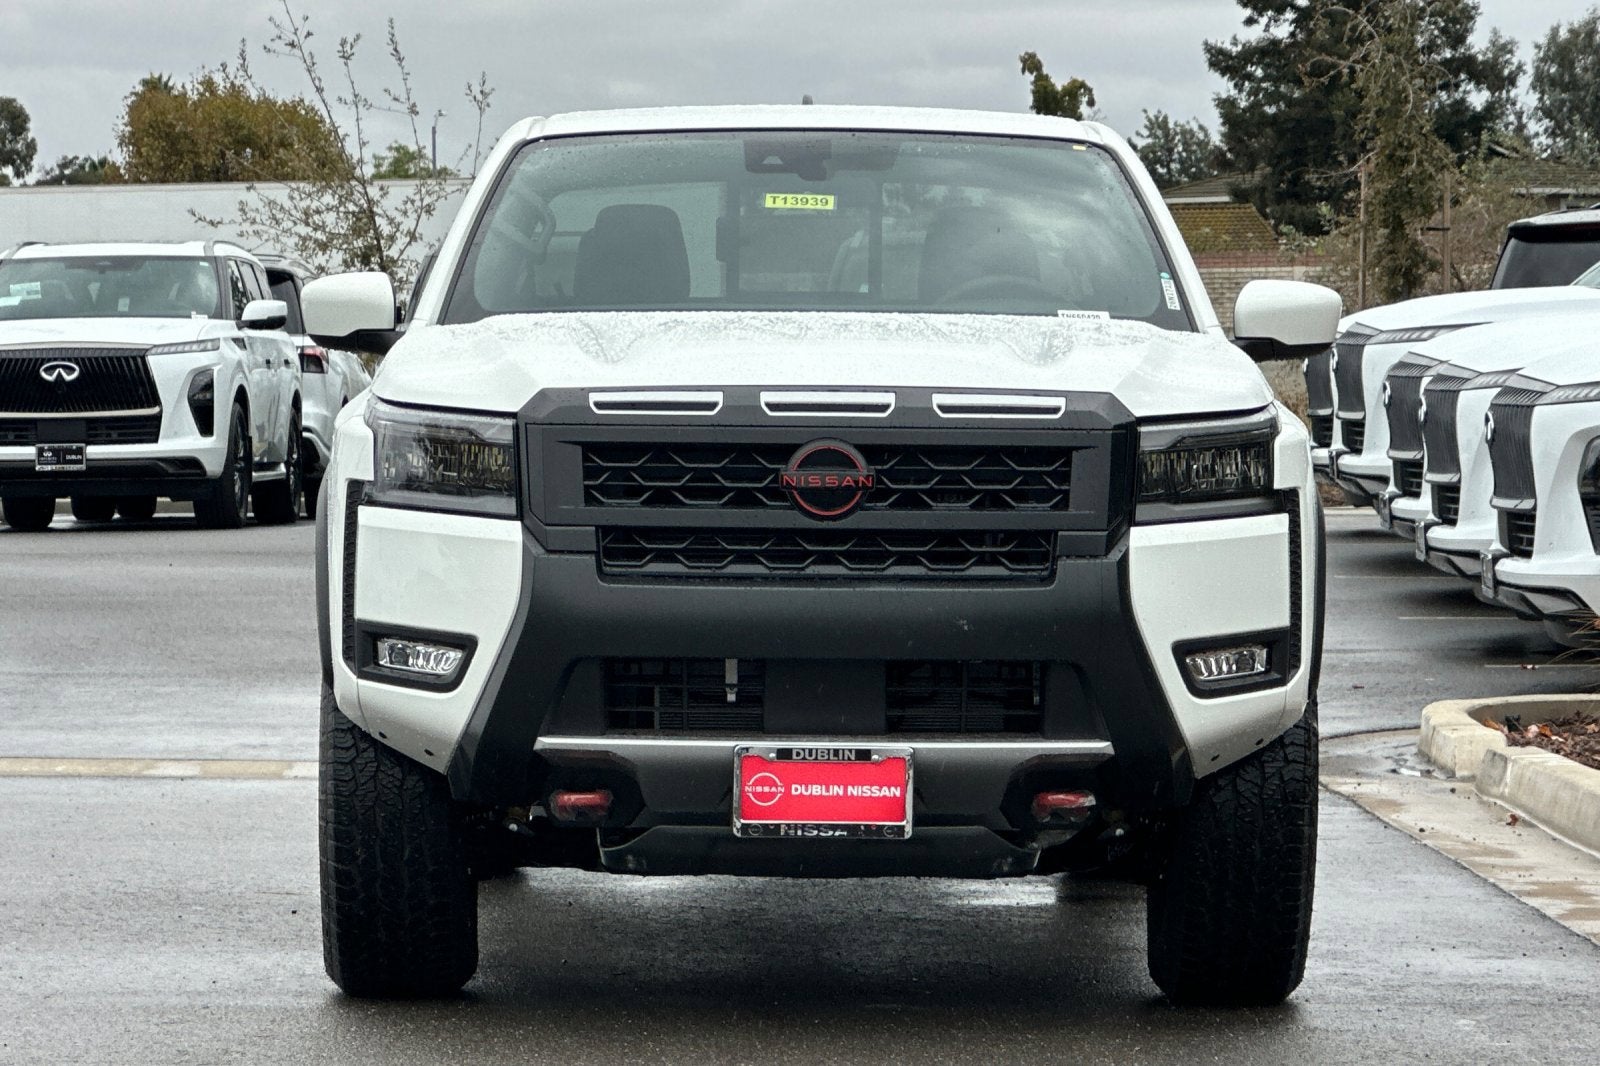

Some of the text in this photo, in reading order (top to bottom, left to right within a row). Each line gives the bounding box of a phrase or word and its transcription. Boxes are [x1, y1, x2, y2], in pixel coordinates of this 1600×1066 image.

[769, 195, 829, 207] T13939
[782, 473, 874, 487] NISSAN
[792, 748, 856, 760] DUBLIN
[745, 785, 785, 793] NISSAN
[791, 784, 901, 797] DUBLIN NISSAN
[780, 823, 848, 836] NISSA
